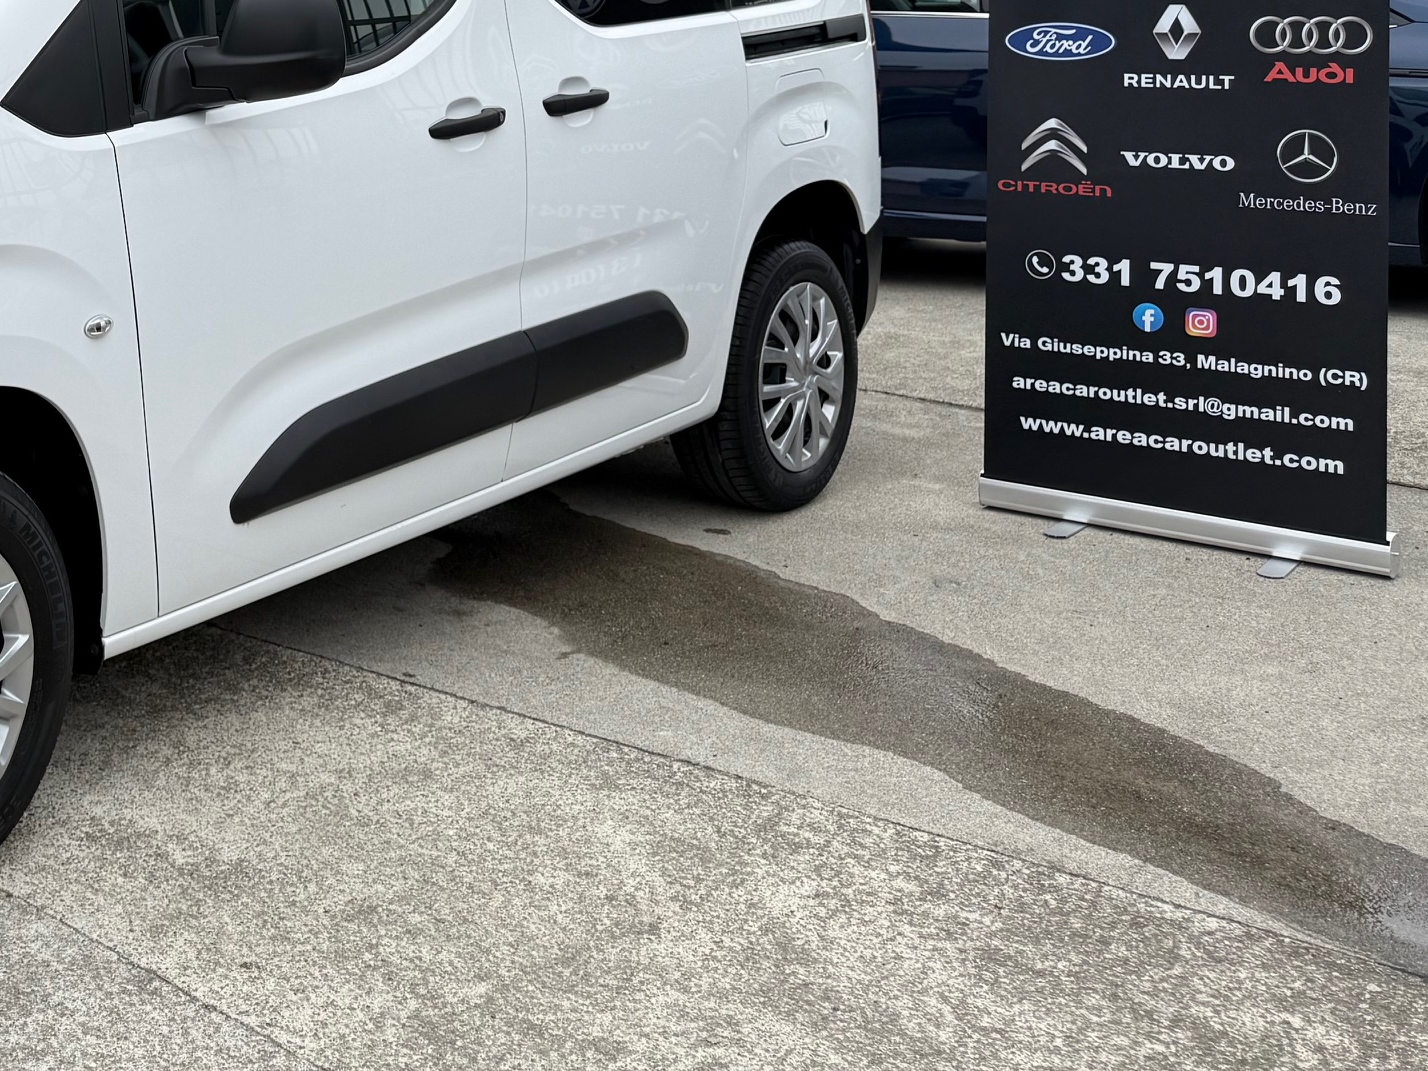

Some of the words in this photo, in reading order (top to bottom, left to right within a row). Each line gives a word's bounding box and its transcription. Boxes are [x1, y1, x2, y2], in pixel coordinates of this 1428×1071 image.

[1025, 29, 1092, 55] Ford
[1123, 73, 1235, 90] RENAULT
[1120, 151, 1236, 172] VOLVO
[997, 179, 1113, 198] CITROËN
[1238, 193, 1378, 216] Mercedes-Benz
[1060, 254, 1131, 287] 331
[1149, 261, 1342, 306] 7510416
[1000, 332, 1031, 350] Via
[1037, 337, 1154, 365] Giuseppina
[1158, 350, 1191, 370] 33,
[1196, 354, 1313, 382] Malagnino
[1318, 367, 1369, 391] (CR)
[1012, 375, 1355, 432] areacaroutlet.srl@gmail.com
[1019, 415, 1344, 476] www.areacaroutlet.com
